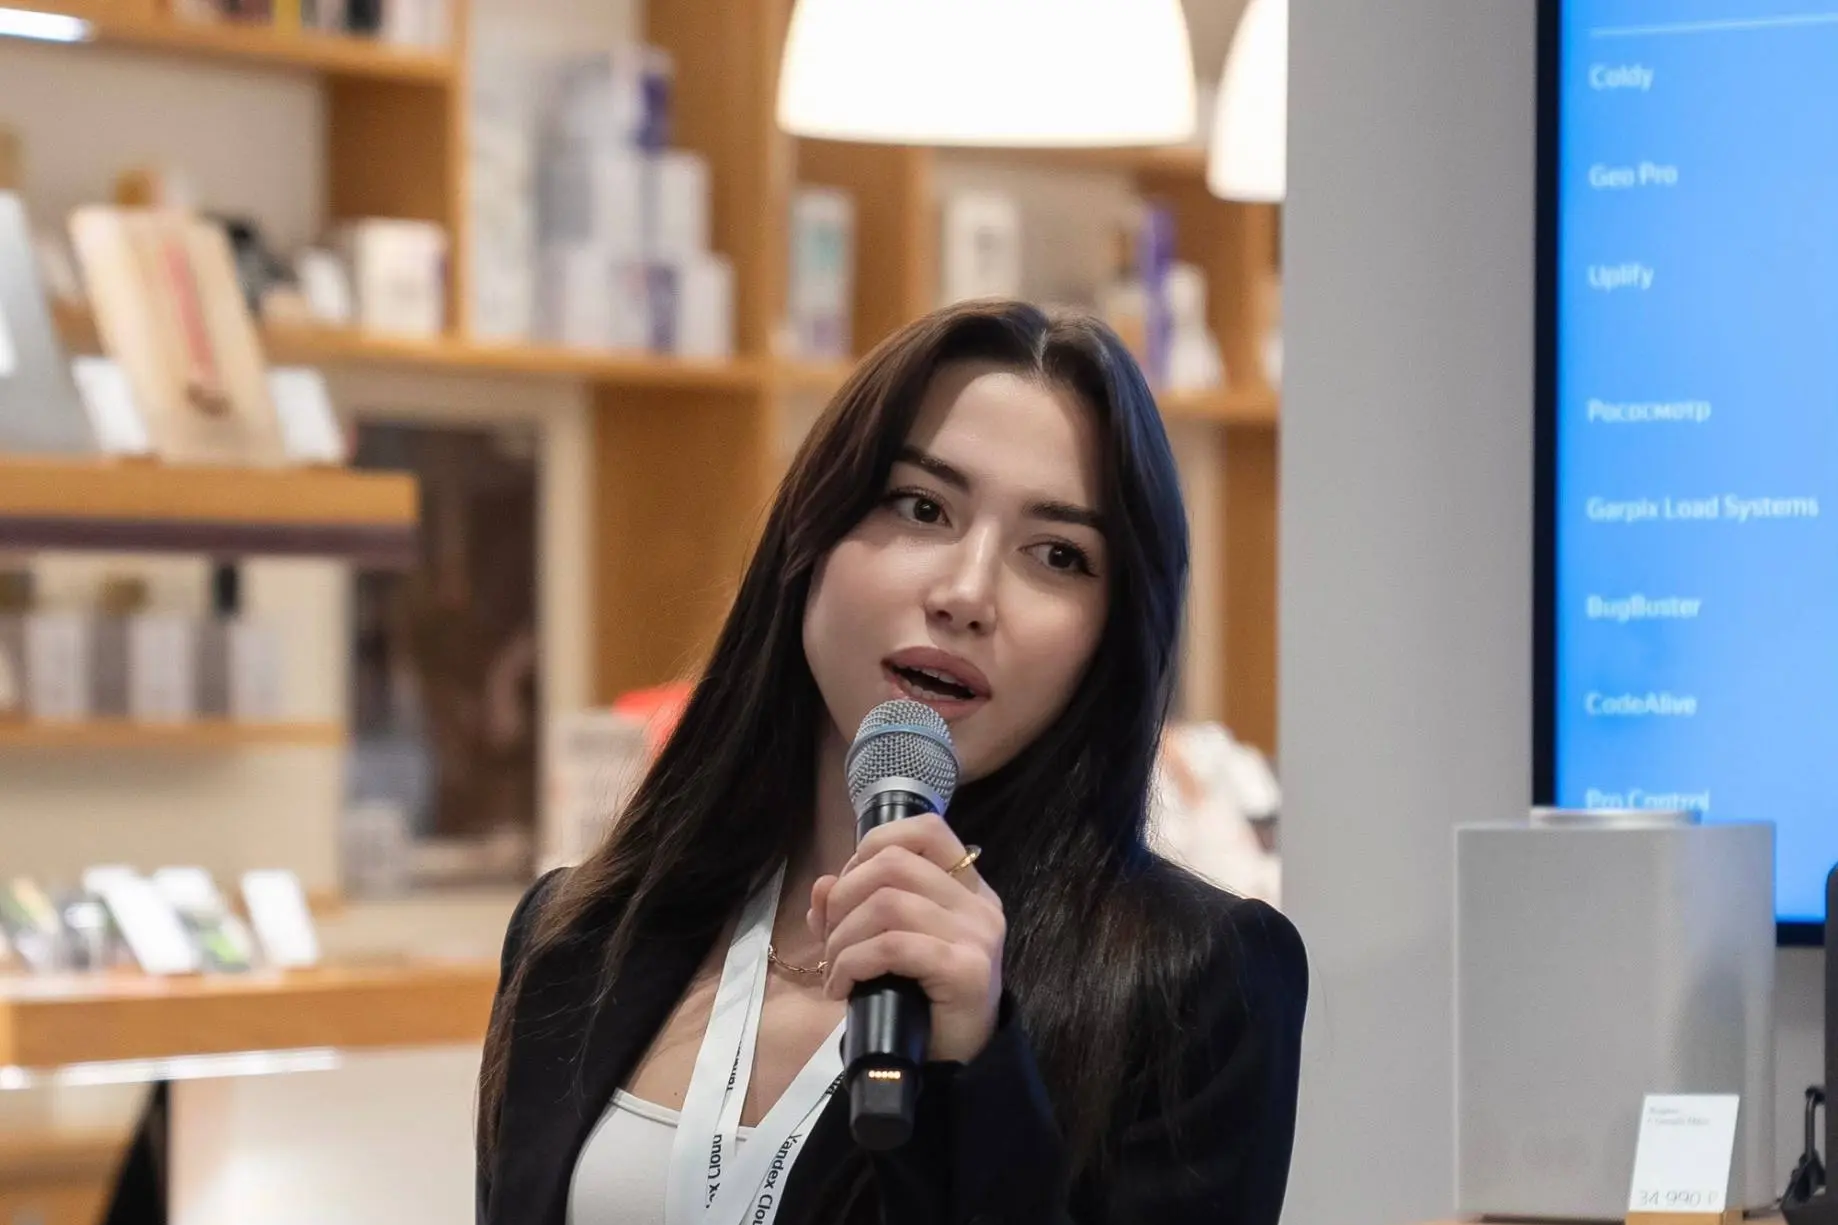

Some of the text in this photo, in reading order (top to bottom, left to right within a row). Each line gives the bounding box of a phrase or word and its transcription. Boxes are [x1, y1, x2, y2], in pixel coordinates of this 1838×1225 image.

[1639, 161, 1678, 185] Pro
[1587, 264, 1654, 292] Uplify
[1665, 497, 1719, 519] Load
[1724, 494, 1820, 523] Systems
[1586, 594, 1701, 624] BugBuster
[1585, 691, 1697, 718] CodeAlive
[764, 1132, 803, 1189] Yandex
